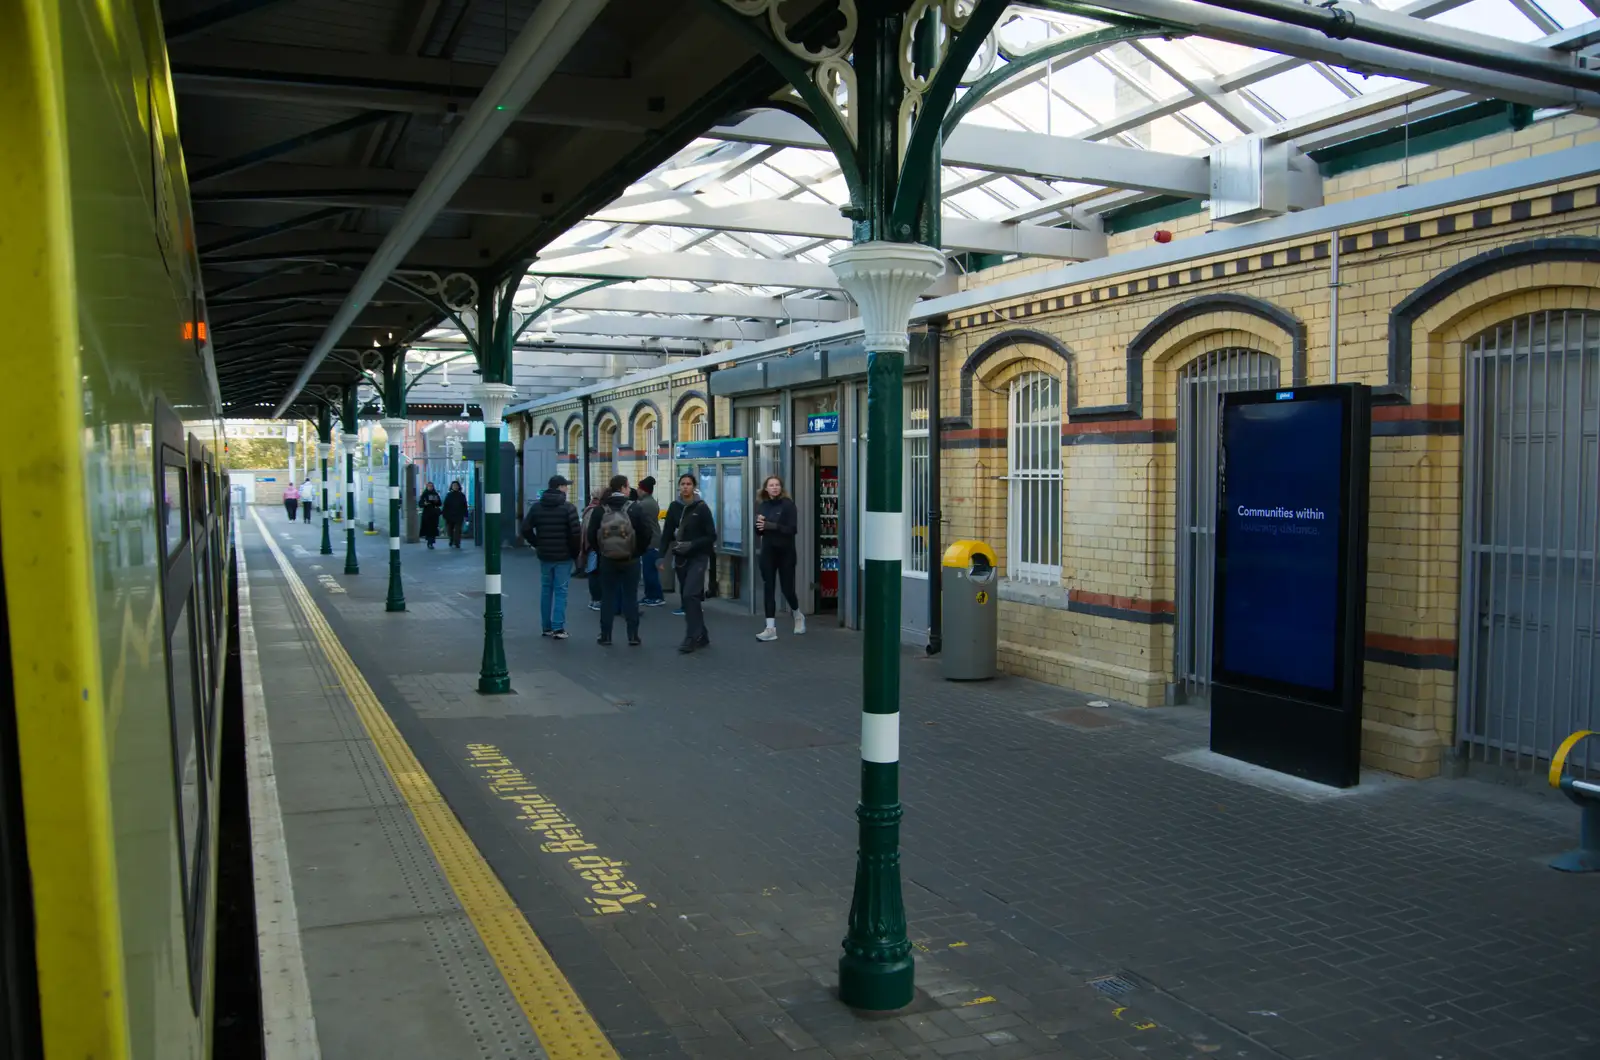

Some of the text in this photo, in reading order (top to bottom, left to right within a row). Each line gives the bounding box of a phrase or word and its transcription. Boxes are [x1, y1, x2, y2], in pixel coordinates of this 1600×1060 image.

[1237, 505, 1325, 520] Communities within
[464, 743, 656, 915] Keep Behind This Line
